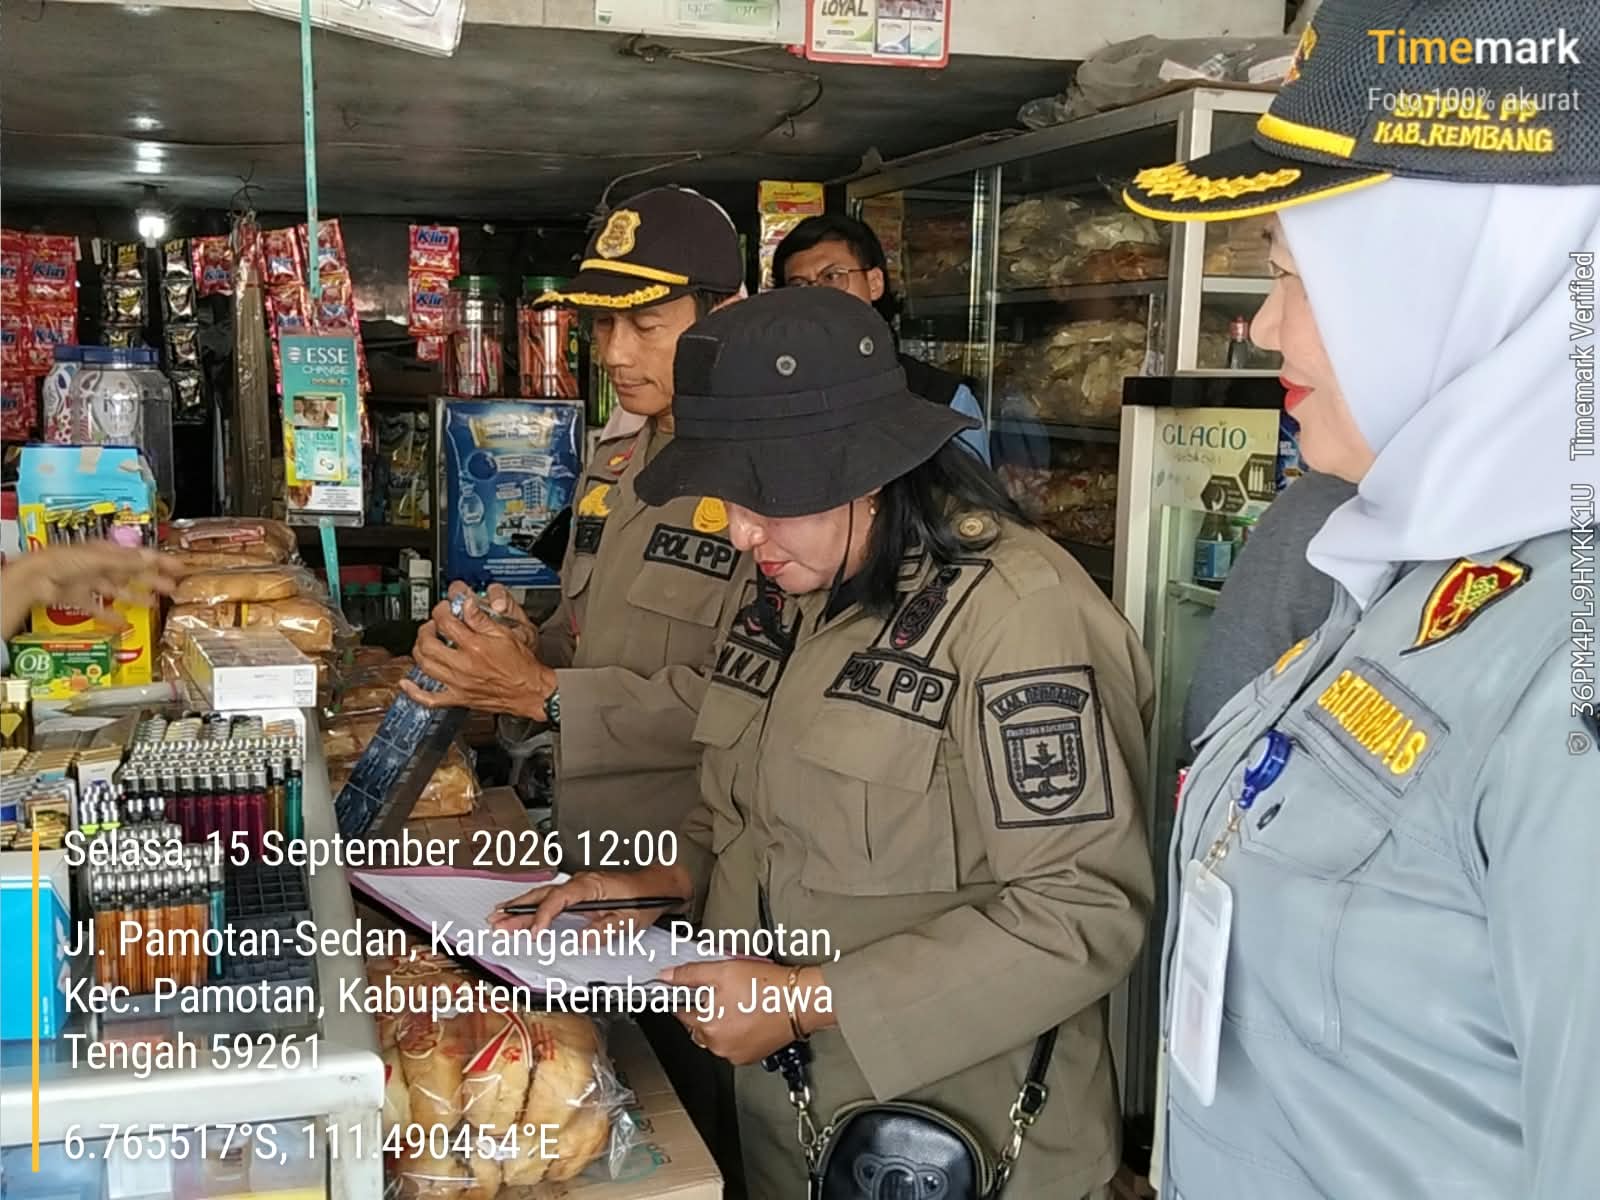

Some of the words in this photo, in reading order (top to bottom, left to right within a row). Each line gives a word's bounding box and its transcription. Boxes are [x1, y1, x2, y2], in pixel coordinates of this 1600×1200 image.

[416, 229, 449, 245] Klin
[33, 262, 66, 278] Klin
[307, 348, 349, 364] ESSE
[1162, 423, 1247, 450] GLACIO
[652, 532, 689, 560] POL
[695, 541, 732, 569] PP
[835, 664, 882, 696] POL
[887, 673, 943, 713] PP
